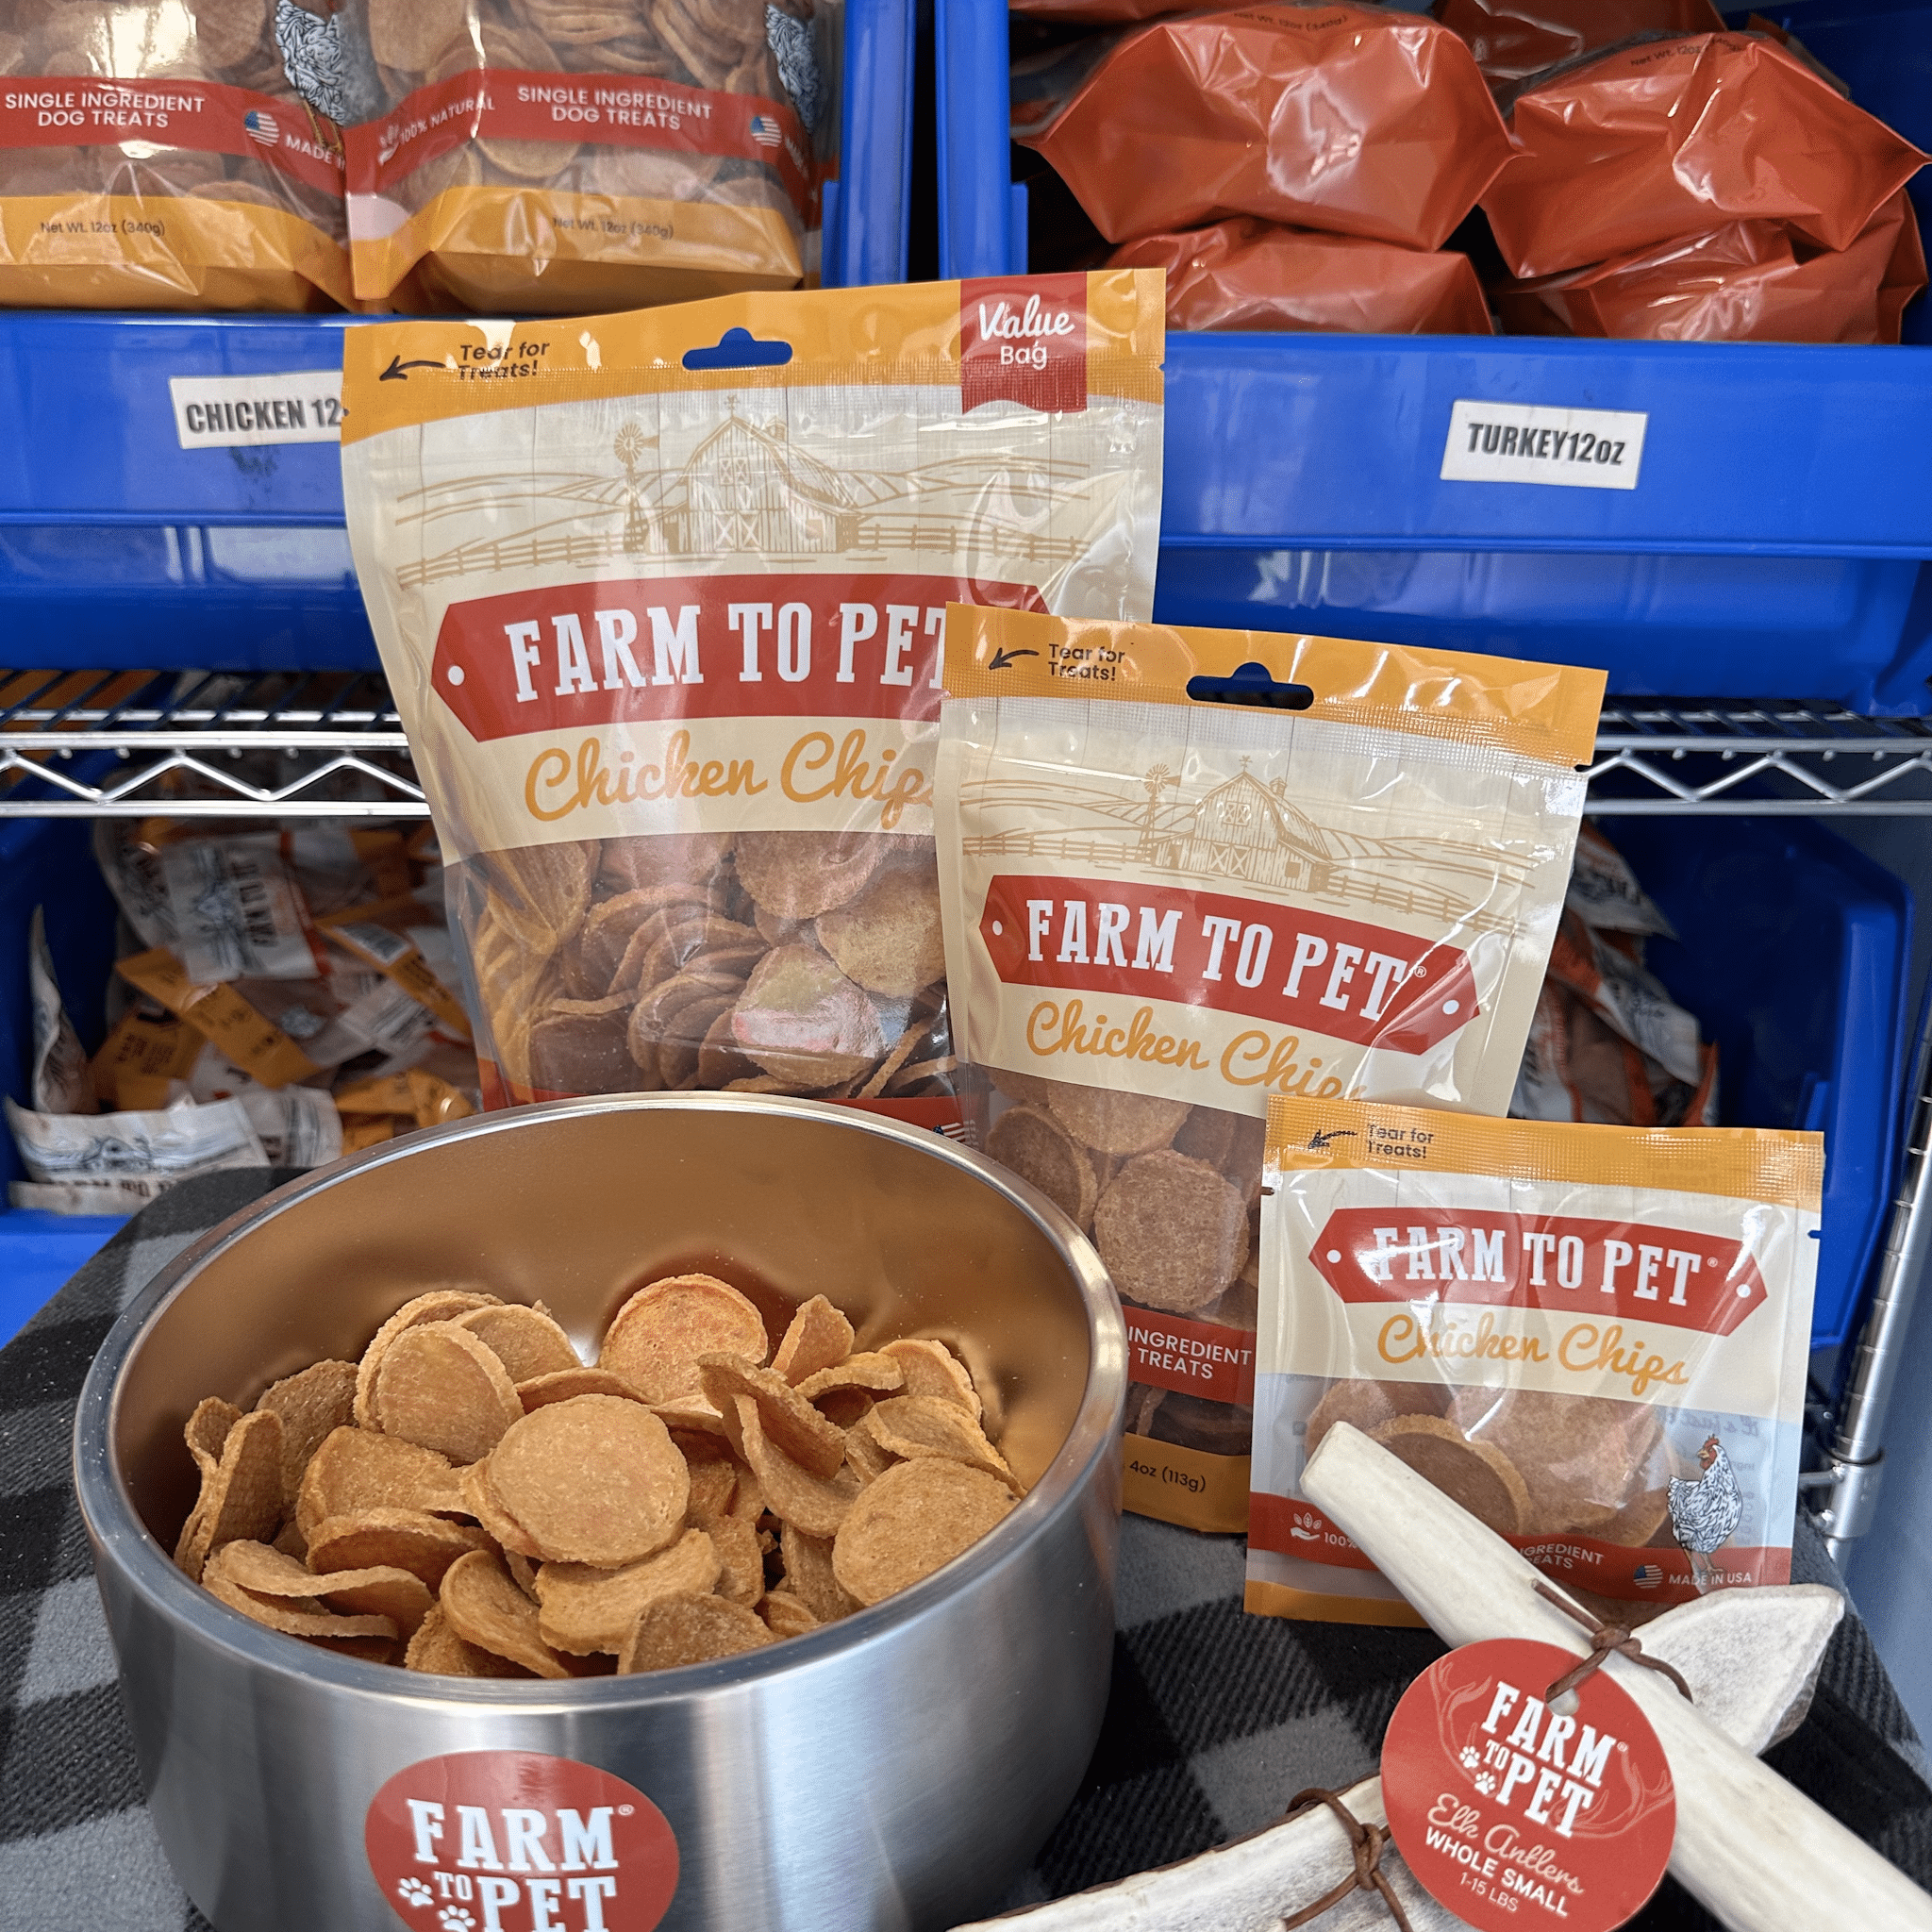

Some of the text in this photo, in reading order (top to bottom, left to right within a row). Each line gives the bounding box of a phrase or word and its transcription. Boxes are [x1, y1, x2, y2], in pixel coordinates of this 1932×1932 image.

[5, 92, 206, 112] SINGLE INGREDIENT
[38, 109, 169, 128] DOG TREATS
[518, 86, 712, 119] SINGLE INGREDIENT
[552, 105, 681, 130] DOG TREATS
[401, 96, 495, 145] 100% NATURAL
[285, 133, 332, 164] MADE
[41, 222, 63, 234] Net
[91, 222, 117, 234] 12oz
[122, 220, 165, 237] (340g)
[978, 293, 1075, 341] Value
[460, 341, 550, 361] Tear for
[1000, 345, 1047, 371] Bag
[458, 359, 539, 380] Treats!
[186, 398, 308, 434] CHICKEN
[1468, 422, 1625, 466] TURKEY12oz
[504, 604, 705, 703] FARM
[729, 601, 812, 683] TO
[1048, 642, 1125, 664] Tear for
[1048, 661, 1117, 682] Treats!
[525, 728, 769, 822] Chicken
[1025, 899, 1183, 974] FARM
[1201, 914, 1274, 990] TO
[1025, 998, 1210, 1072] Chicken
[1366, 1140, 1427, 1159] Treats!
[1368, 1124, 1434, 1144] Tear for
[1373, 1226, 1507, 1283] FARM
[1523, 1232, 1584, 1291] TO
[1128, 1325, 1253, 1366] INGREDIENT
[1377, 1311, 1690, 1396] Chicken Chips
[1138, 1347, 1214, 1380] TREATS
[1129, 1459, 1207, 1493] 4oz (113g)
[1669, 1572, 1753, 1585] MADE IN USA
[1482, 1738, 1595, 1839] TO PET
[1426, 1791, 1585, 1896] Elk Antlers
[1424, 1826, 1569, 1918] WHOLE SMALL
[433, 1870, 618, 1932] TO PET
[1459, 1871, 1520, 1914] 1-15 LBS
